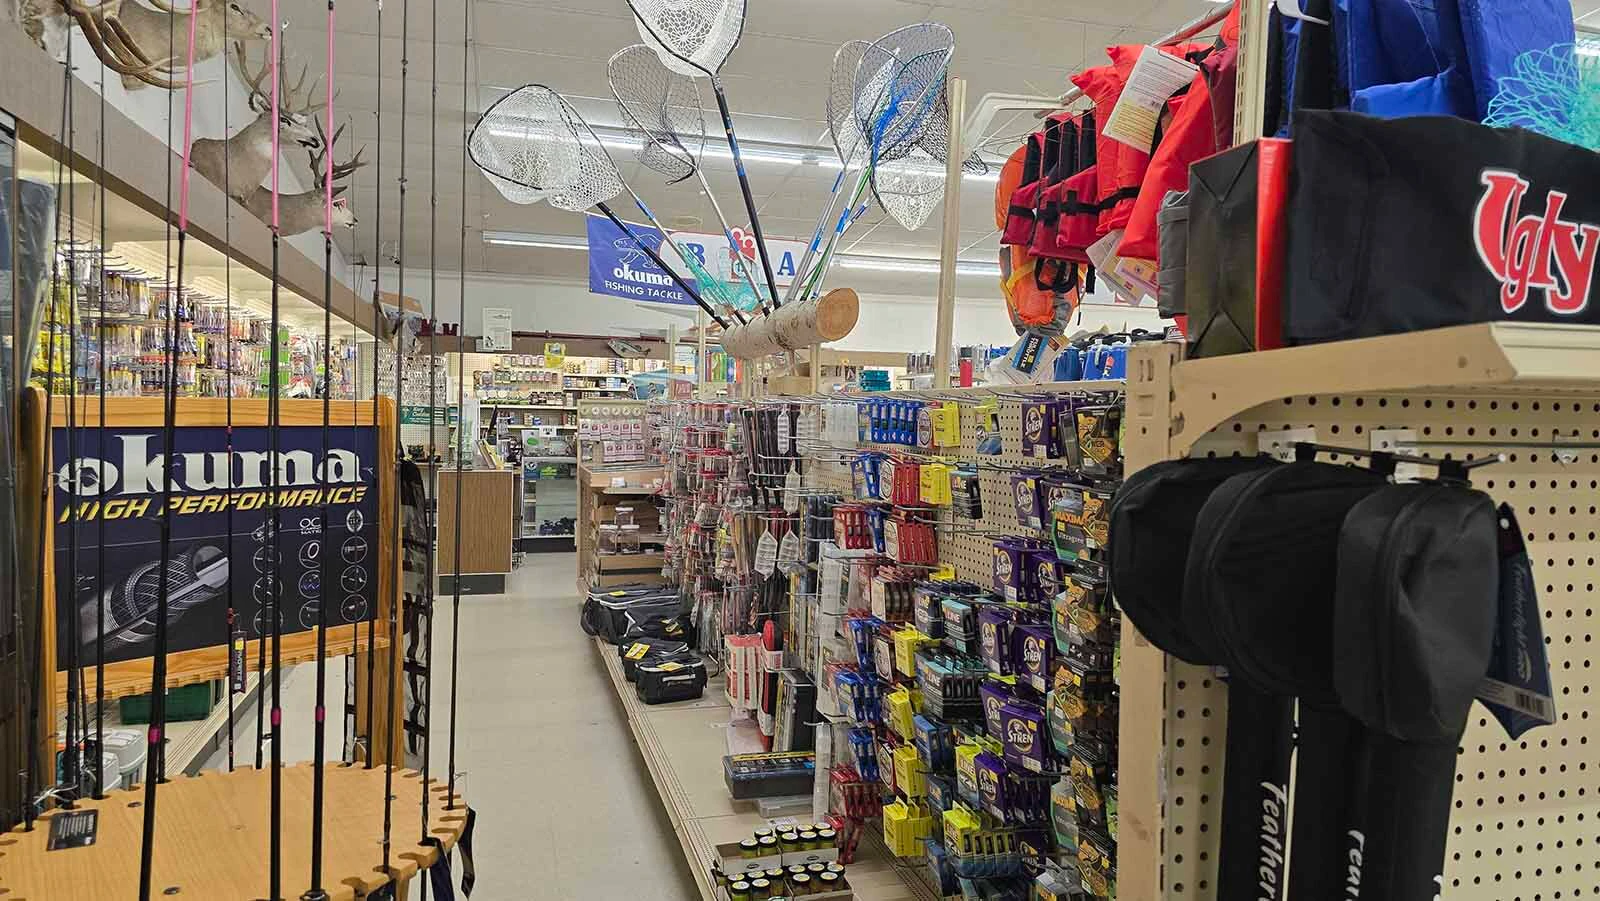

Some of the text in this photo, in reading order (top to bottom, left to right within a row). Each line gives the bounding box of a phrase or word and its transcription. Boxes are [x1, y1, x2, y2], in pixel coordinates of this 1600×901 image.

[1473, 167, 1600, 314] Ugly
[613, 263, 674, 287] okuma
[777, 251, 797, 277] A
[604, 279, 684, 300] FISHING TACKLE
[57, 433, 367, 497] okuma
[57, 486, 367, 523] HIGH PERFORMANCE
[1007, 730, 1034, 744] STREN
